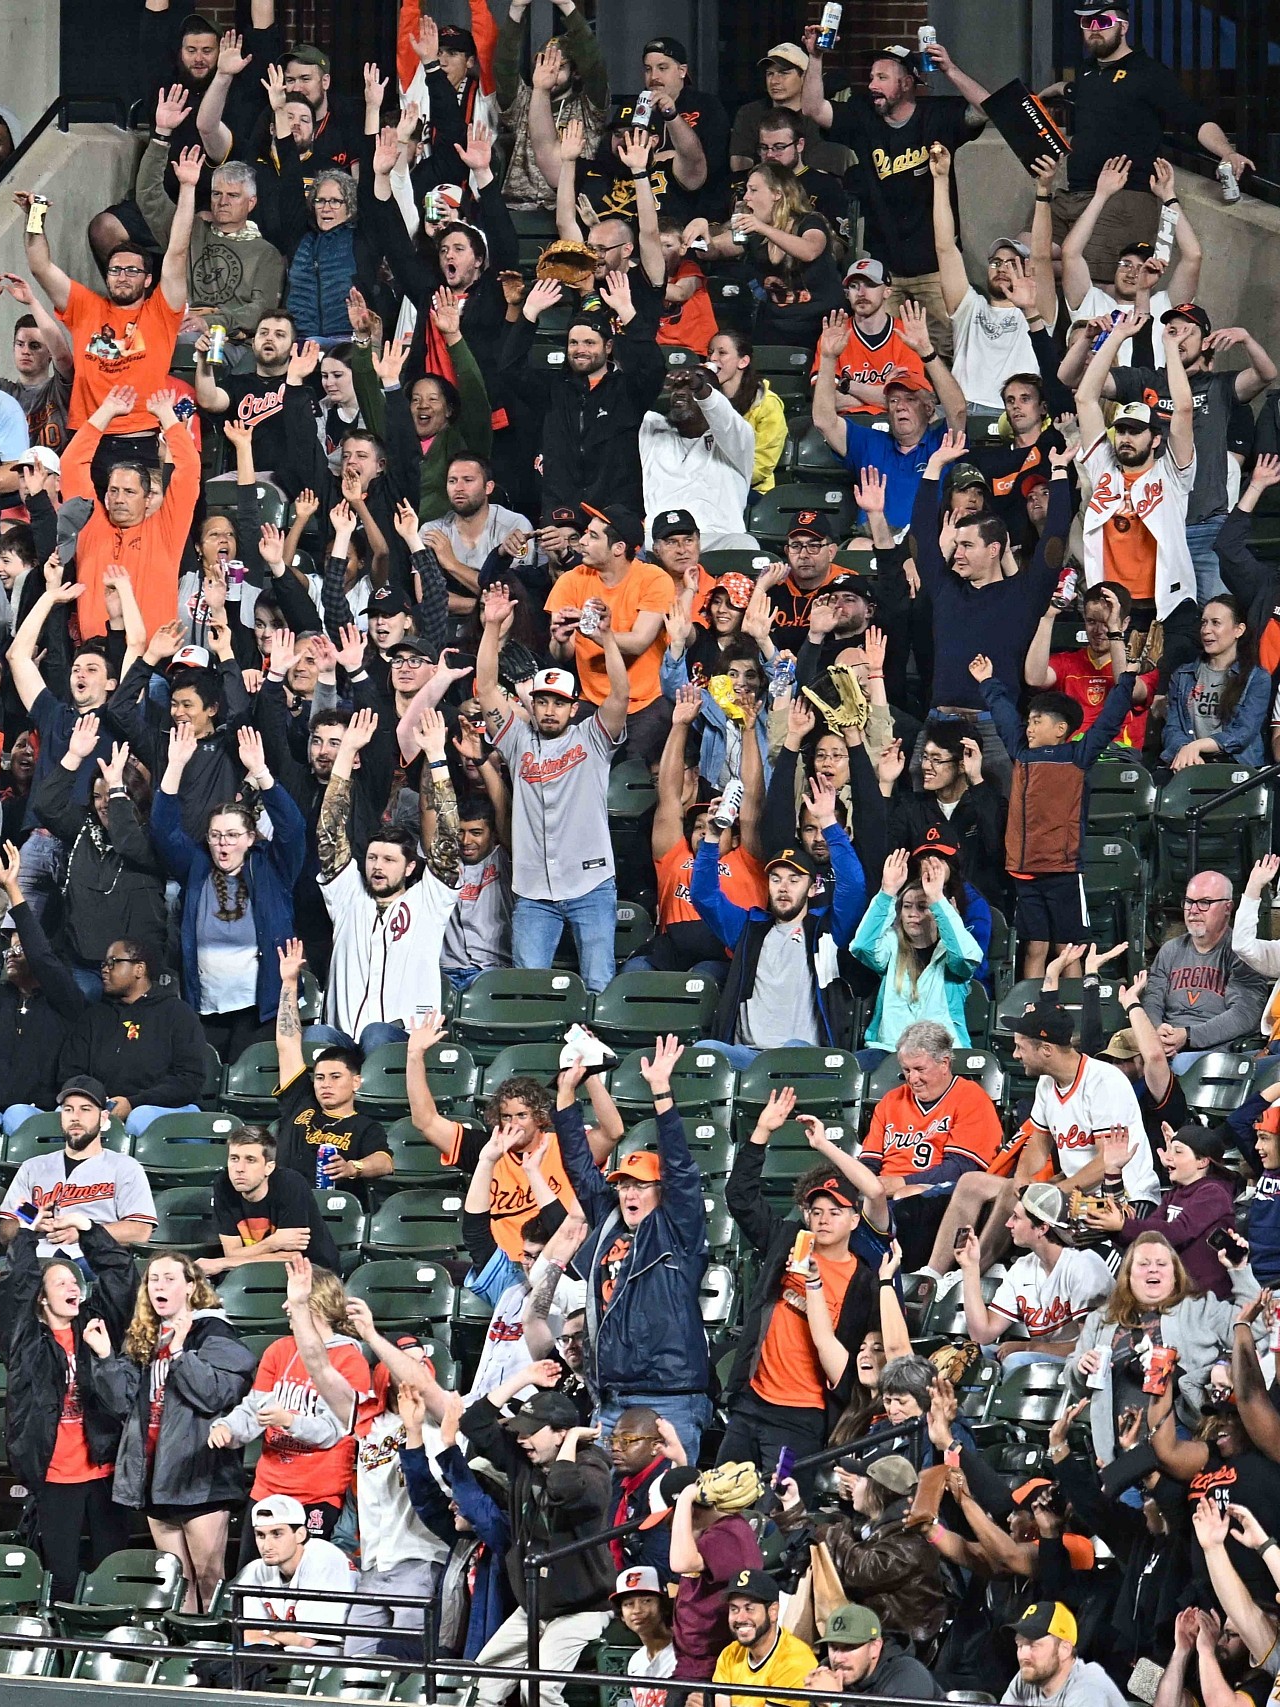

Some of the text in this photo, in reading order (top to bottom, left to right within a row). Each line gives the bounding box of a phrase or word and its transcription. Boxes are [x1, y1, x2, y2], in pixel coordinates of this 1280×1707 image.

[237, 383, 287, 420] Oriol
[1197, 703, 1218, 718] CIT
[1170, 967, 1225, 997] VIRGINI
[1186, 990, 1202, 1007] V
[912, 1142, 932, 1169] 9
[316, 1160, 324, 1189] ULTRA
[1214, 1488, 1230, 1500] DK
